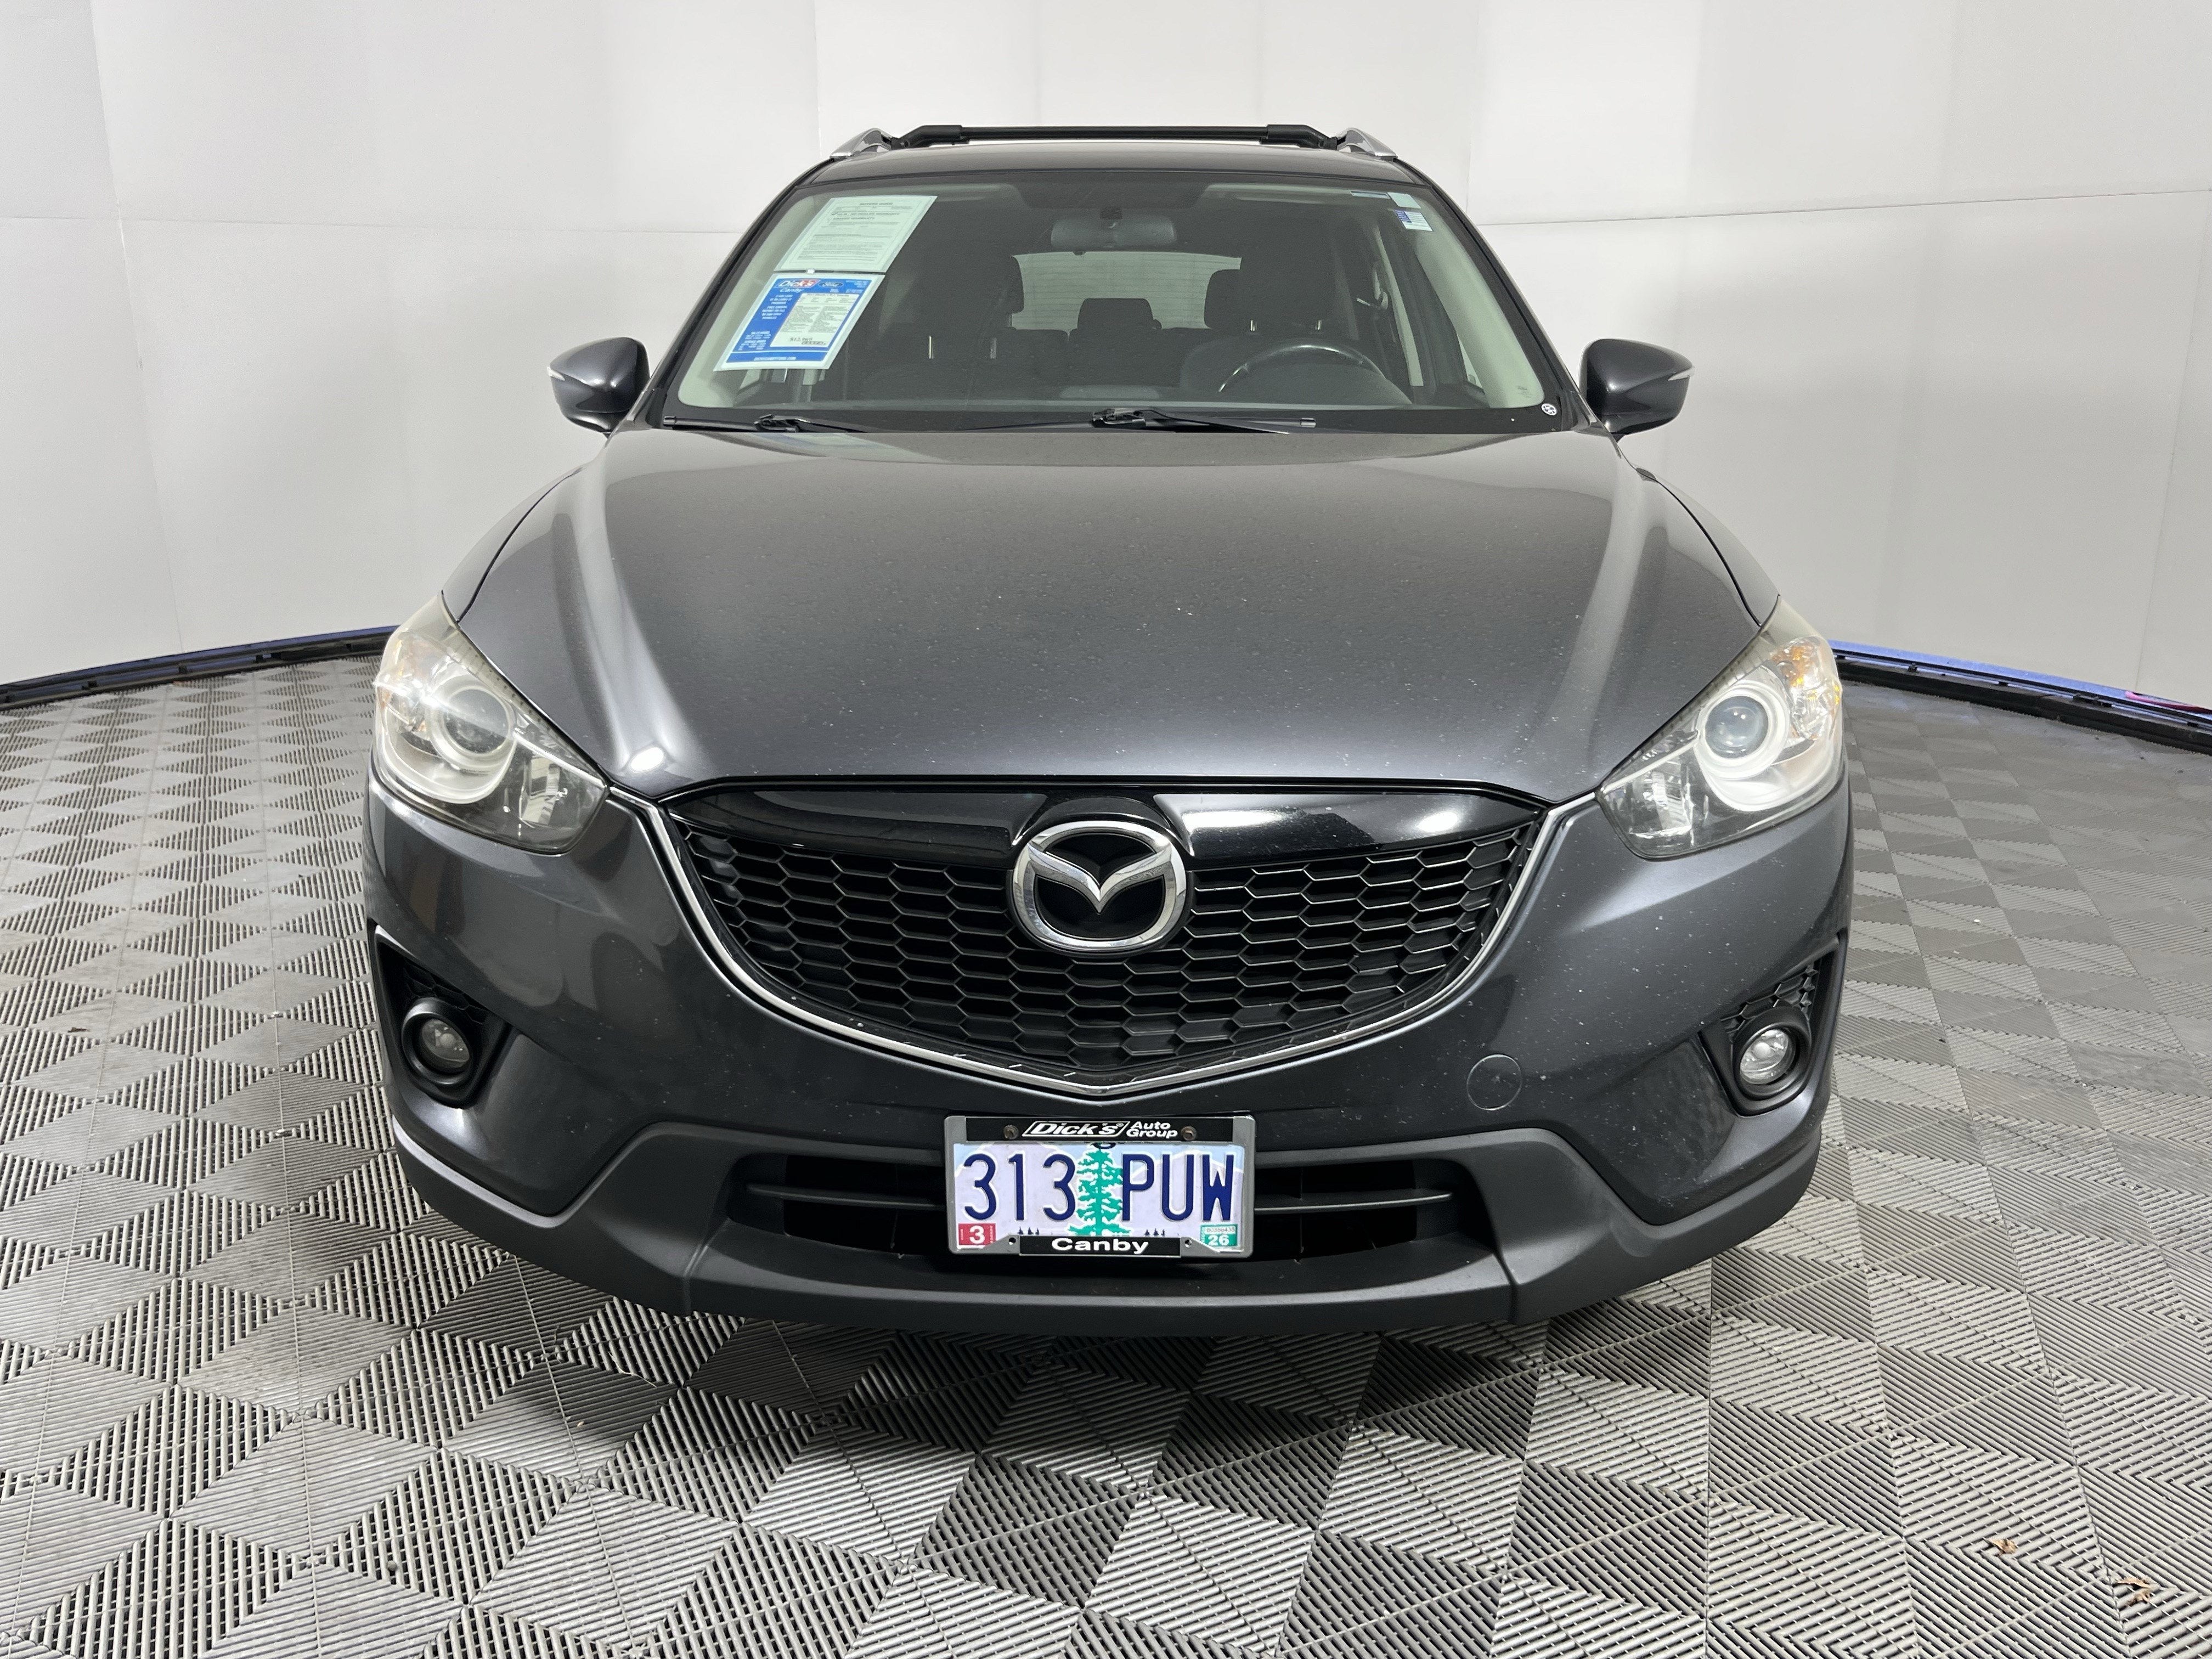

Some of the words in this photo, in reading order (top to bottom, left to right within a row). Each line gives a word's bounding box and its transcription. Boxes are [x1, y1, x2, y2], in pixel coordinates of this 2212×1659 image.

[1030, 1122, 1118, 1135] Dick's
[1130, 1121, 1171, 1130] Auto
[1126, 1128, 1178, 1139] Group
[963, 1153, 1076, 1221] 313
[1122, 1154, 1234, 1221] PUW
[969, 1225, 985, 1244] 3
[1207, 1235, 1229, 1246] 26
[1051, 1237, 1149, 1255] Canby
